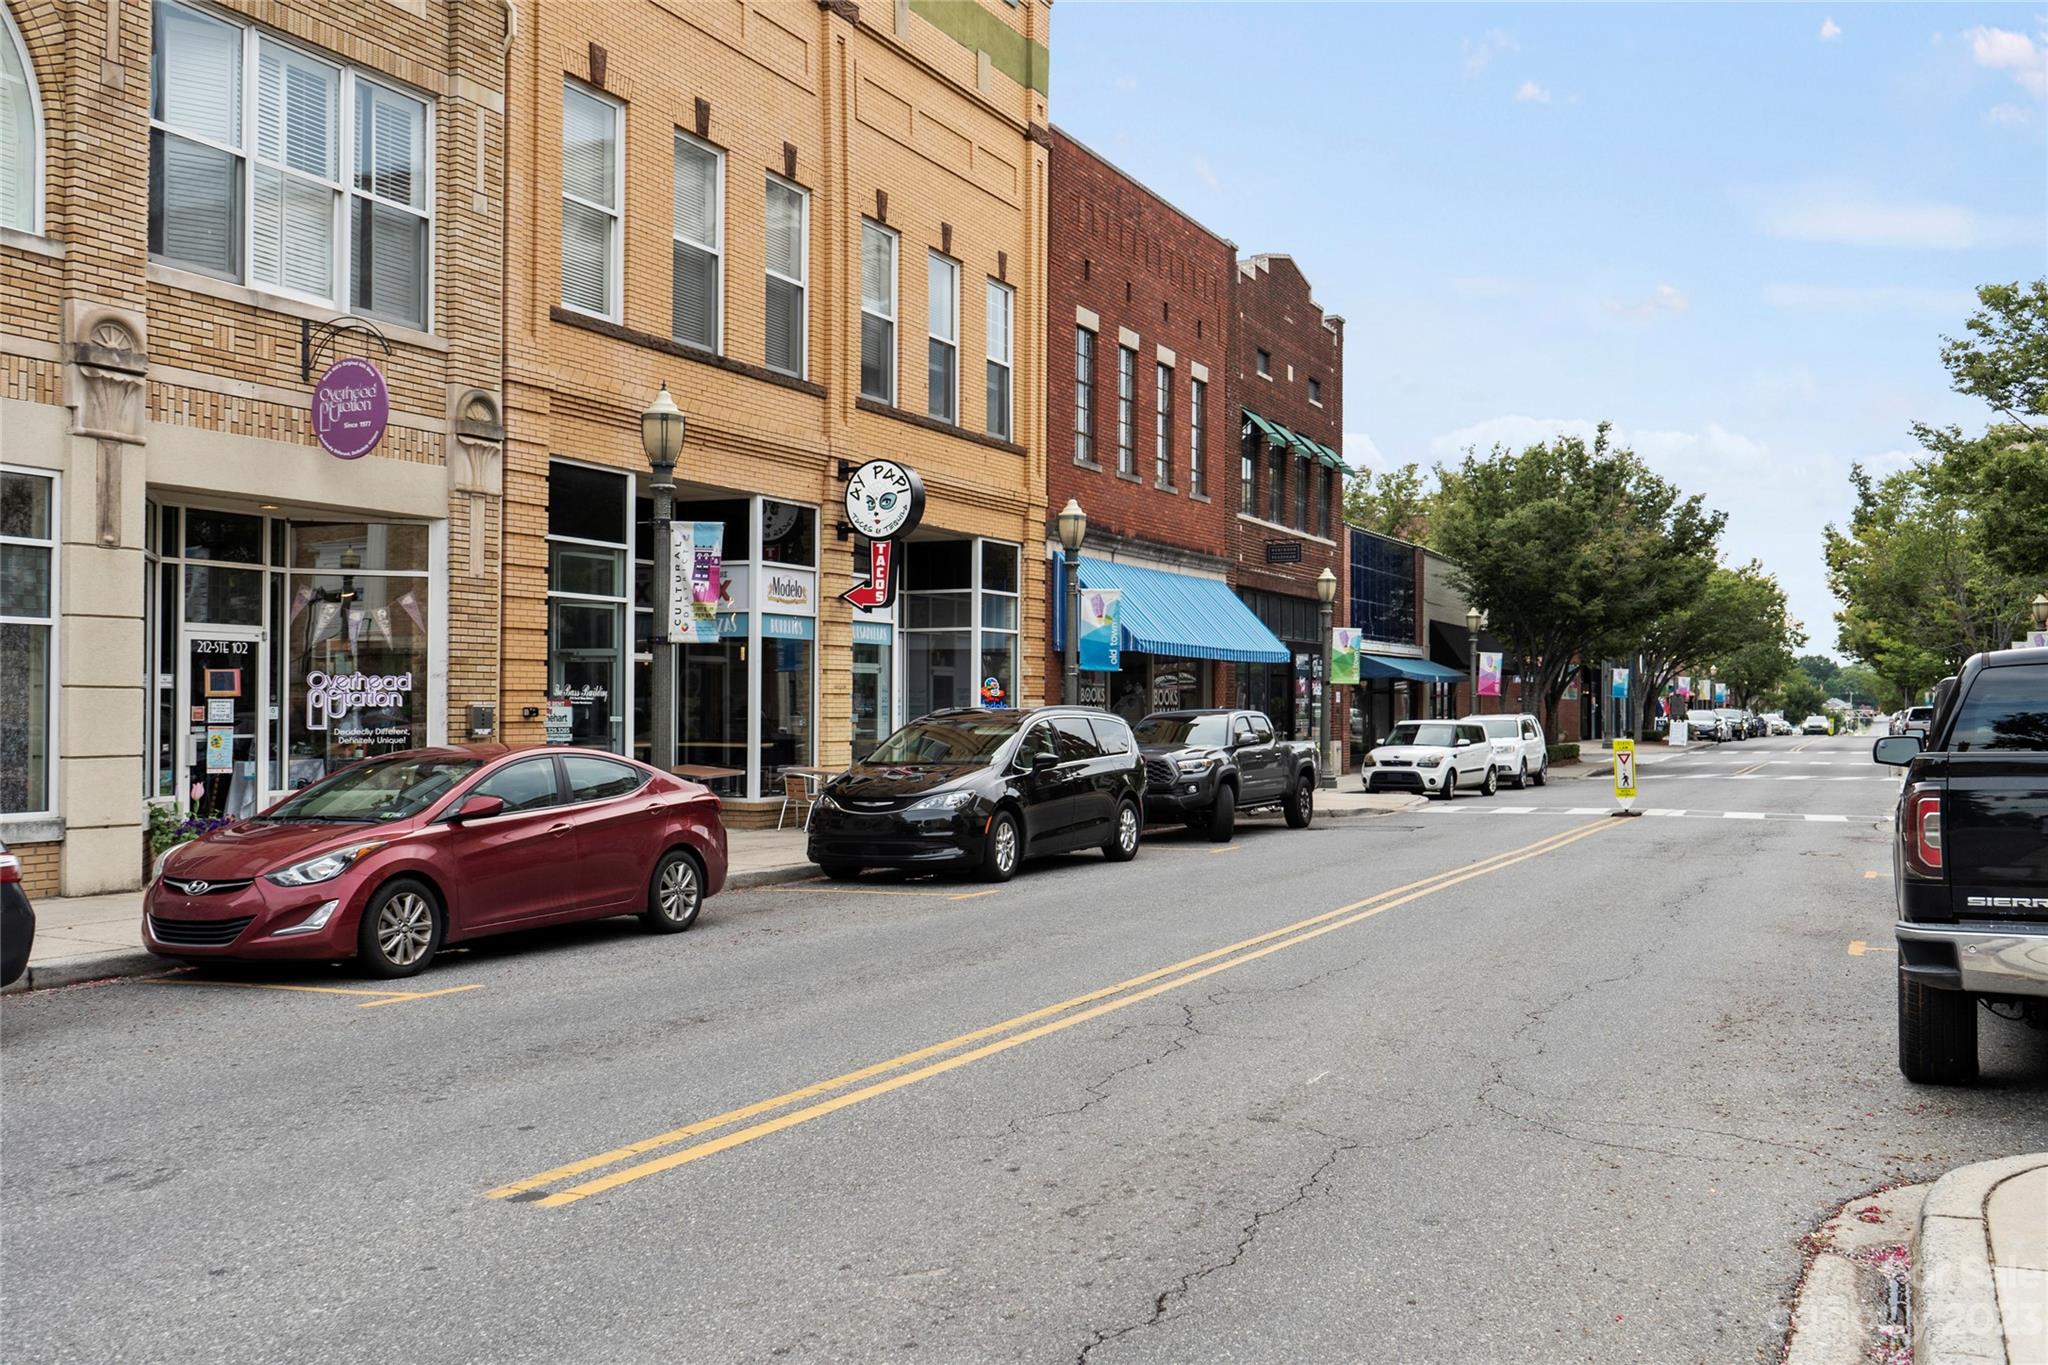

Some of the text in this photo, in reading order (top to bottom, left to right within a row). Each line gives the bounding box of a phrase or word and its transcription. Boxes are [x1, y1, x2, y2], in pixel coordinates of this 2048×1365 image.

[320, 383, 378, 403] Overhead
[344, 421, 358, 429] Since
[872, 465, 910, 494] PAPI
[853, 513, 873, 533] TACOS
[883, 504, 908, 532] TEQUILA
[875, 543, 887, 602] TACOS
[674, 541, 683, 626] CULTURAL
[772, 577, 803, 599] Modelo
[197, 640, 249, 655] 212-STE 102
[1109, 621, 1119, 665] old town
[306, 671, 412, 691] Overhead
[1080, 687, 1105, 703] BOOKS
[1153, 689, 1179, 706] BOOKS
[333, 727, 411, 737] Decidedly Different,
[338, 736, 407, 745] Definitely Unique!
